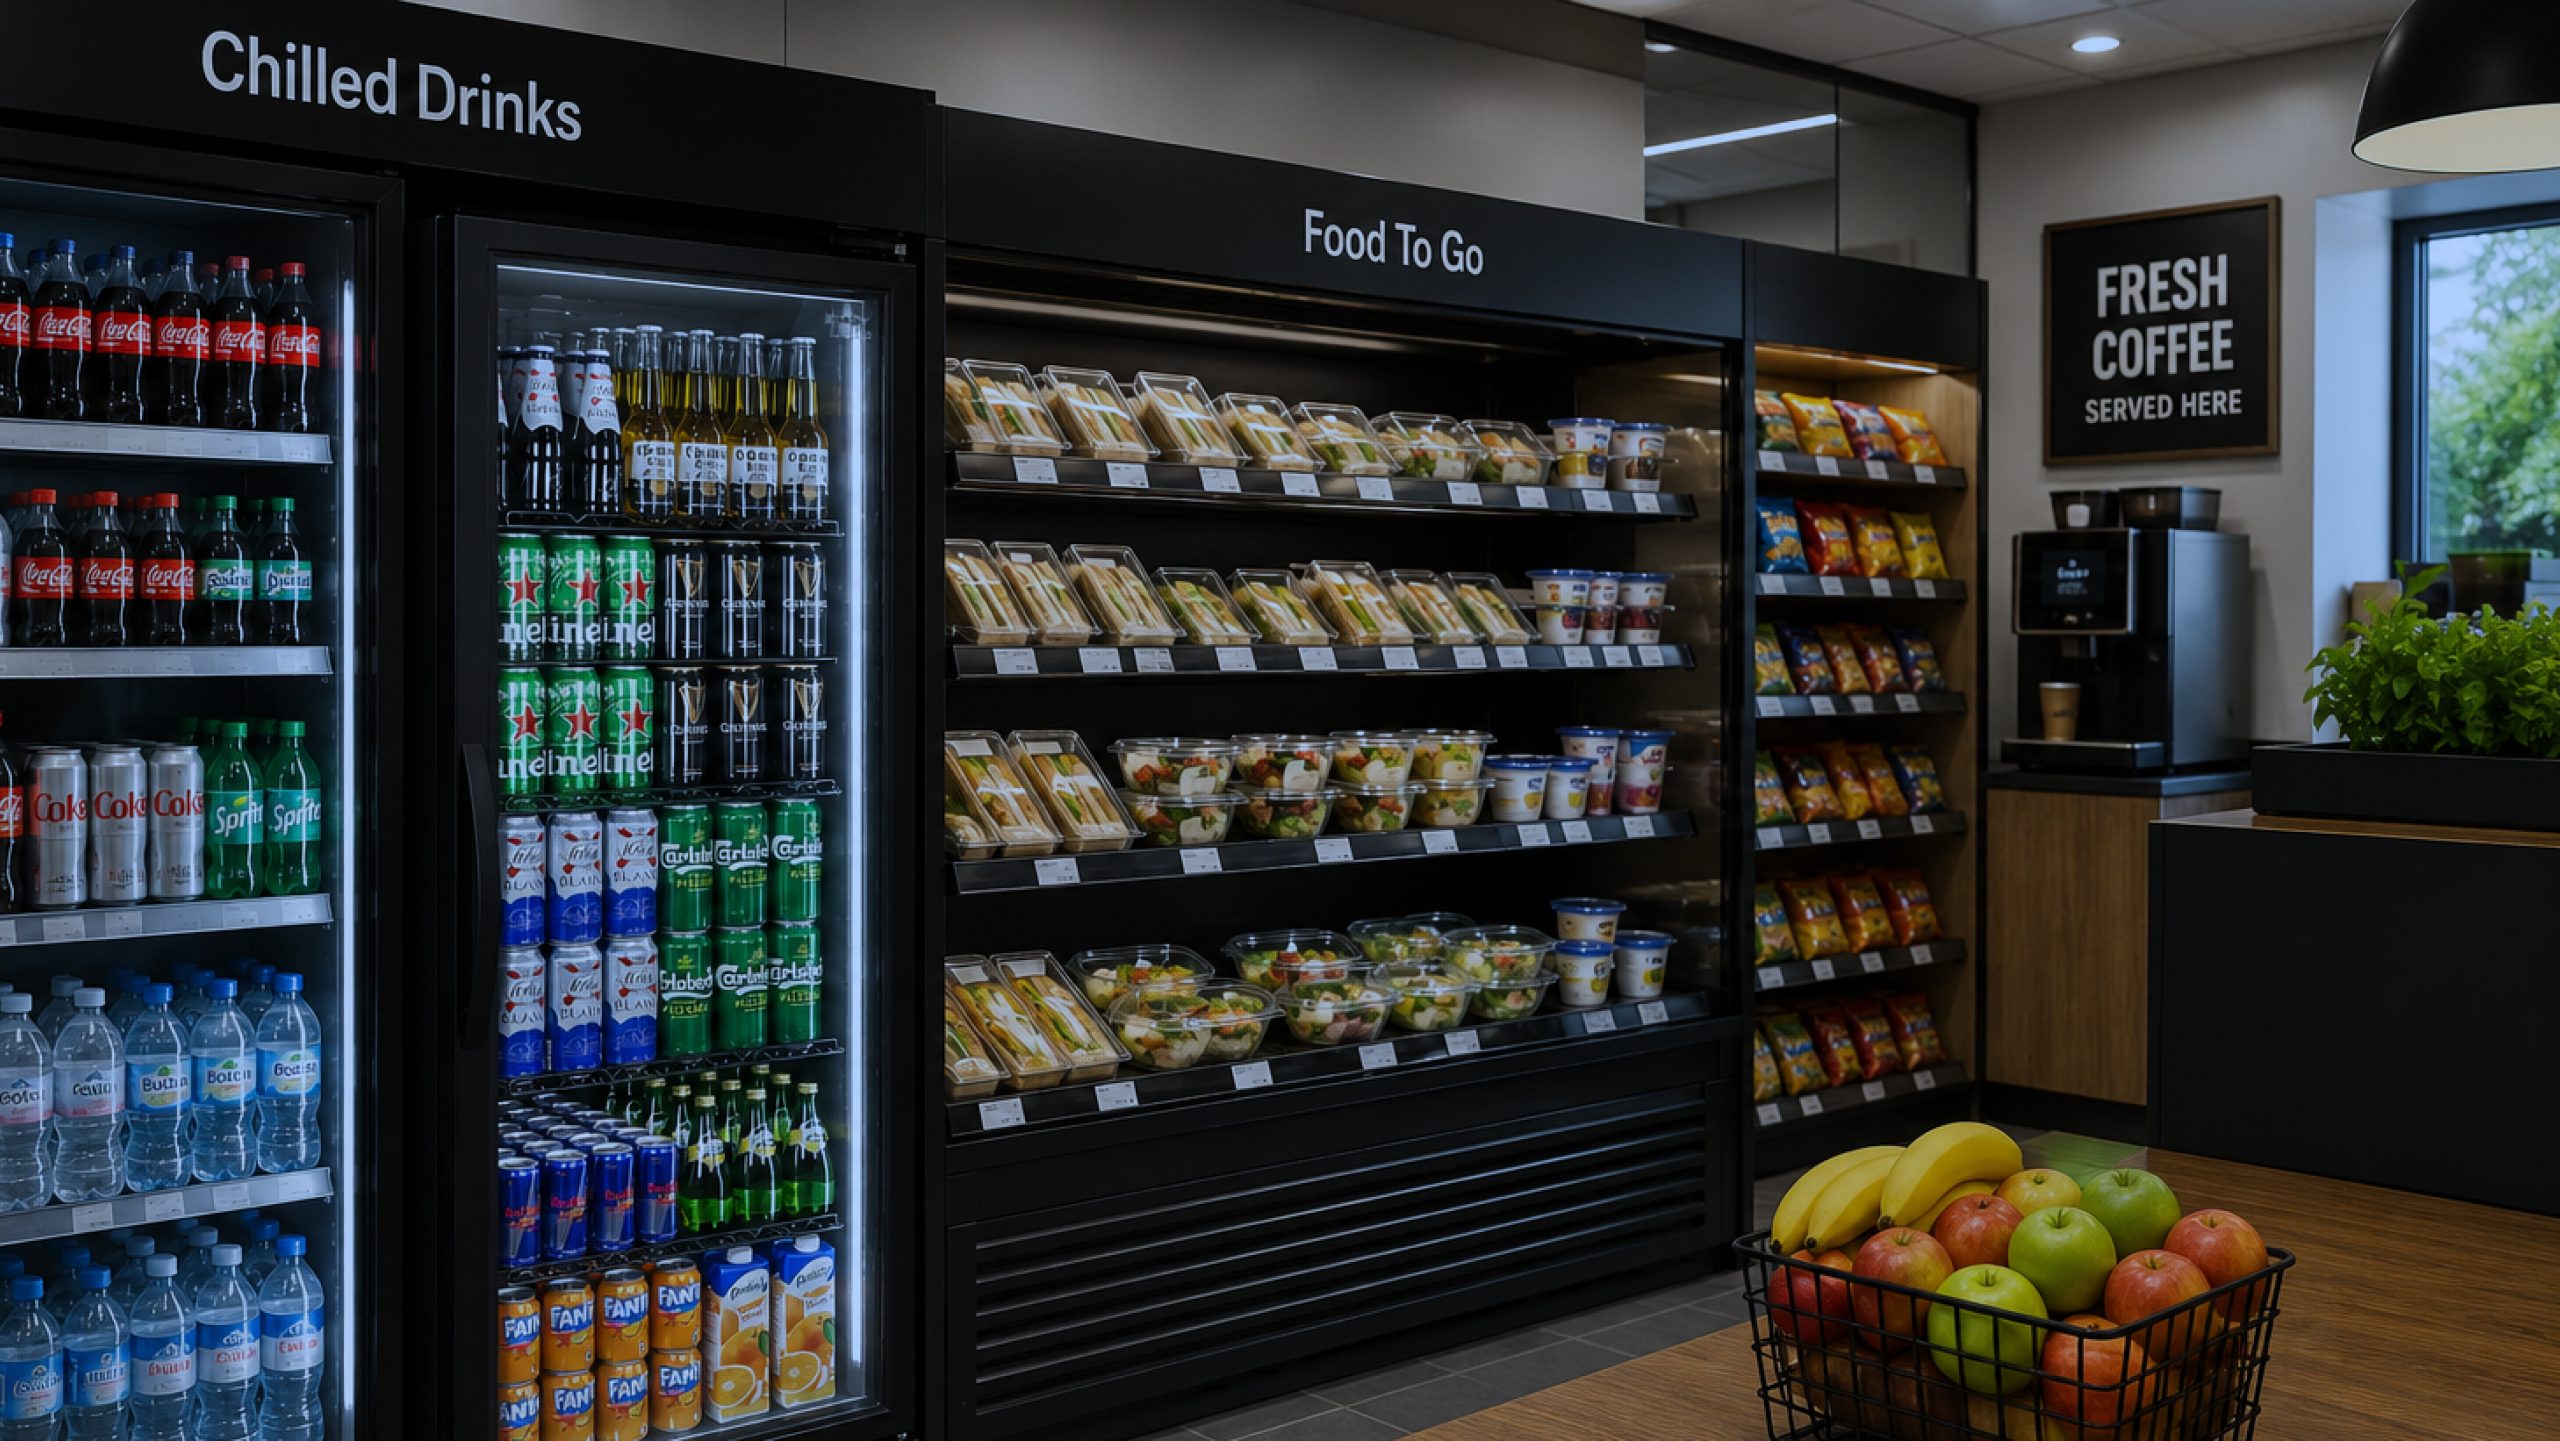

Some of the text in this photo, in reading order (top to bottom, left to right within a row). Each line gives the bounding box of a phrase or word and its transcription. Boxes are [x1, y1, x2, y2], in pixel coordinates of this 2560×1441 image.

[202, 30, 582, 141] Chilled Drinks
[1305, 208, 1484, 275] Food To Go
[2097, 254, 2228, 319] FRESH
[2092, 319, 2234, 380] COFFEE
[2085, 389, 2242, 424] SERVED HERE
